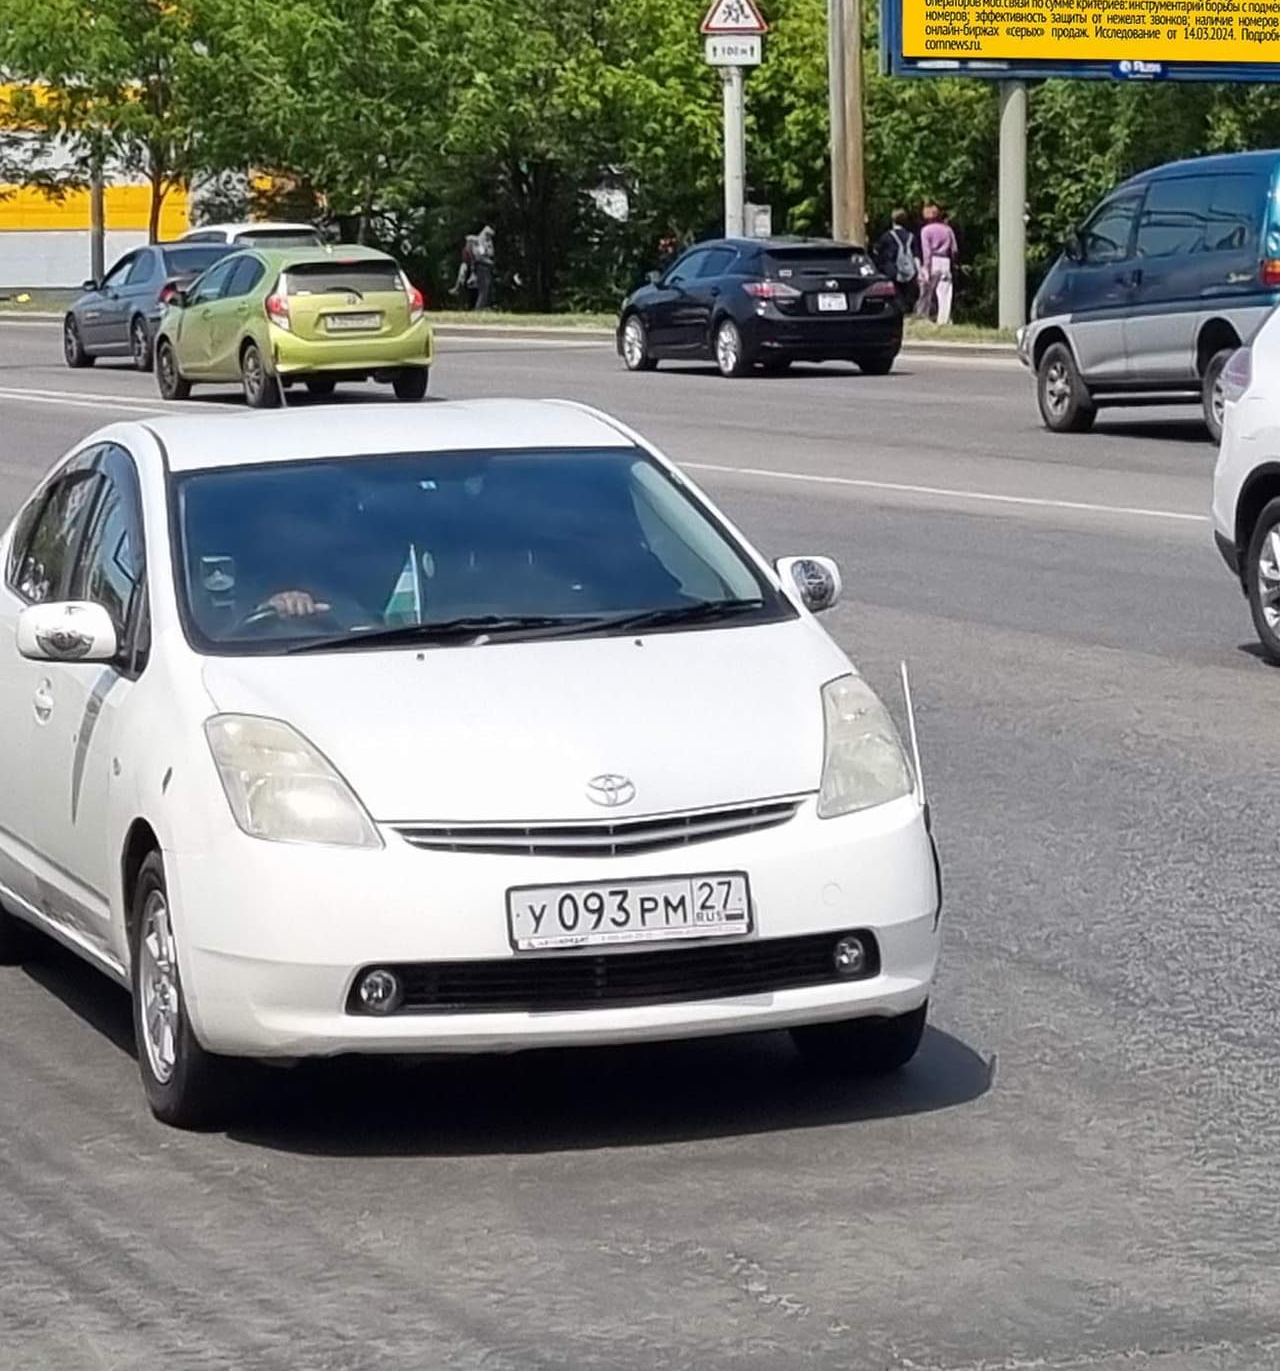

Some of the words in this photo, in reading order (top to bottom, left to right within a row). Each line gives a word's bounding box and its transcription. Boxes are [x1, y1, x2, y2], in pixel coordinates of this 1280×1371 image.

[1045, 0, 1074, 12] сумме
[1205, 0, 1240, 15] борьбы
[1242, 3, 1247, 12] с
[976, 9, 1047, 25] эффективность
[1051, 13, 1087, 25] защиты
[1092, 14, 1102, 24] от
[1195, 16, 1234, 26] наличие
[1239, 17, 1279, 29] номеров
[925, 24, 999, 39] онлайн-биржах
[1006, 26, 1045, 40] «серых»
[1095, 25, 1161, 40] Исследование
[1167, 29, 1177, 39] от
[528, 889, 688, 933] У093РМ
[698, 880, 732, 911] 27
[696, 911, 724, 922] RUS
